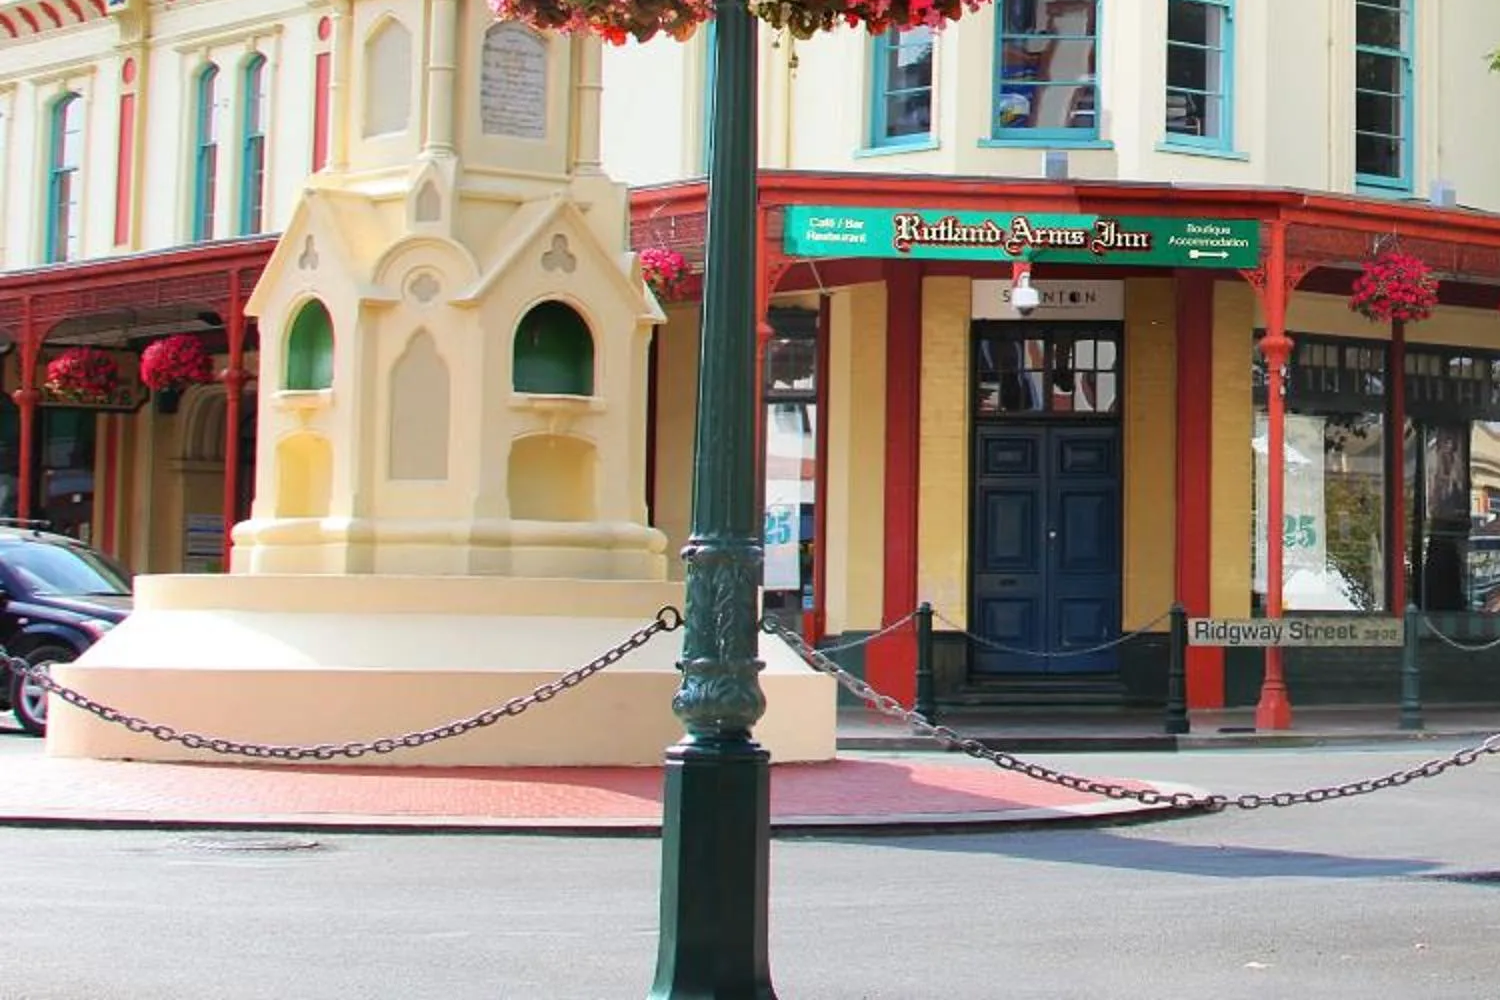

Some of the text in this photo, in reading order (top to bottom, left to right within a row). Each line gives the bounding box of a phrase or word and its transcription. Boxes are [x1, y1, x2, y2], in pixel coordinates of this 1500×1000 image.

[845, 218, 865, 230] Bar
[1186, 223, 1231, 236] Boutique
[806, 230, 867, 243] Restaurant
[894, 215, 1149, 253] Rutland Arms Inn
[1167, 235, 1249, 248] Accommodation
[1002, 289, 1097, 304] SNTON
[1194, 620, 1283, 645] Ridgway
[1288, 621, 1359, 641] Street
